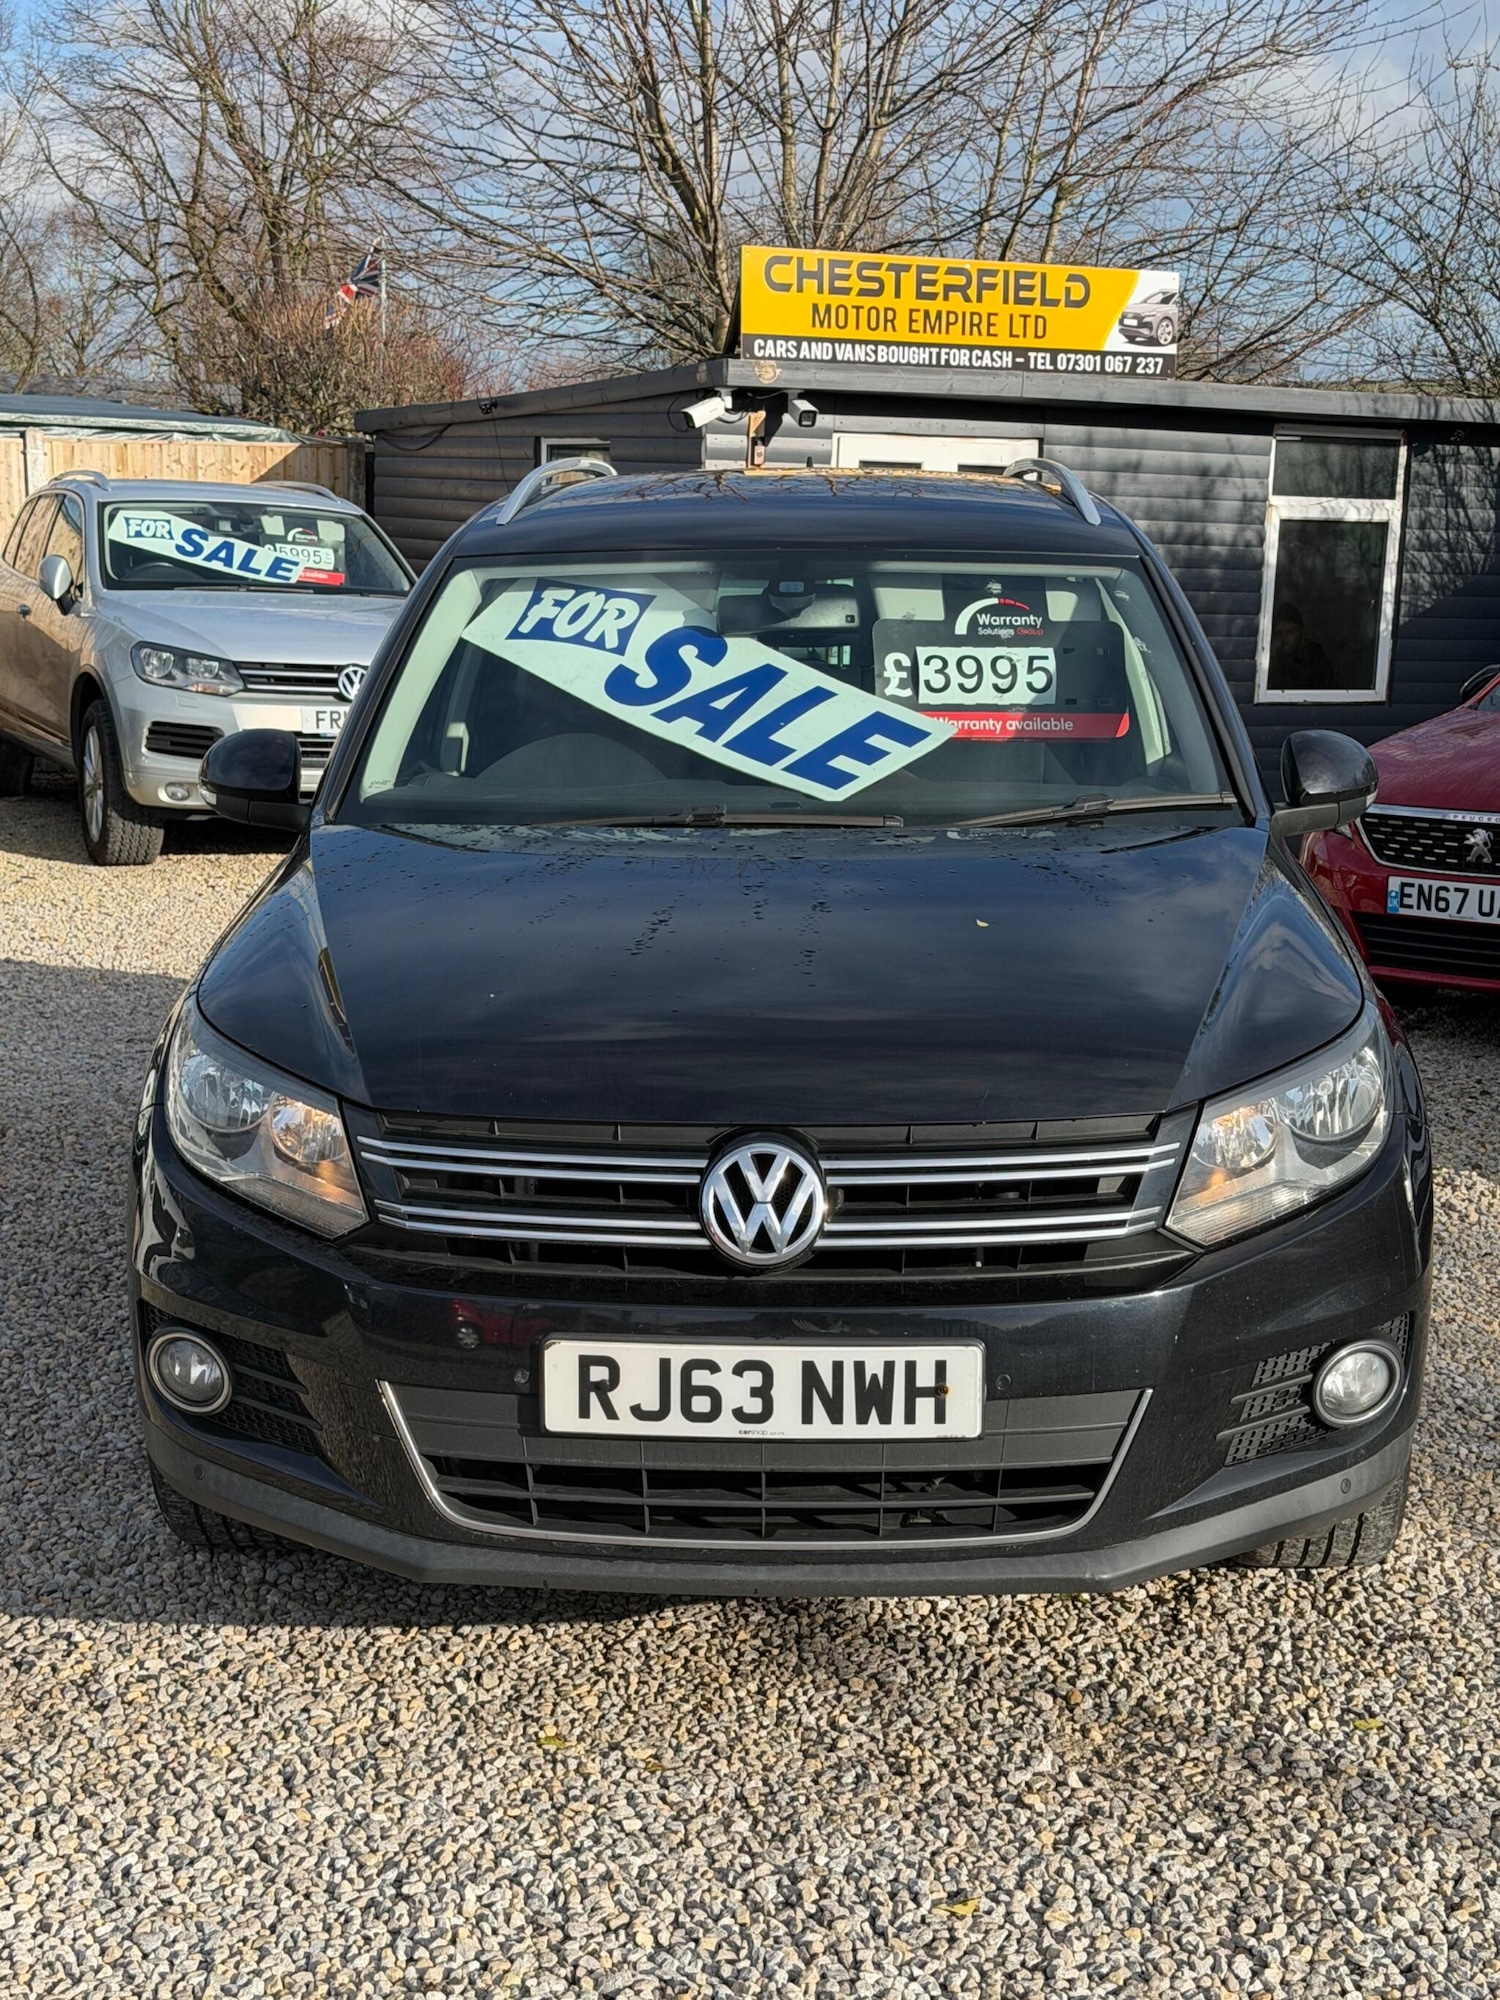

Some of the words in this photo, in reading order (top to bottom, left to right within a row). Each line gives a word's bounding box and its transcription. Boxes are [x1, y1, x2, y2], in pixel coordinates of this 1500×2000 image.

[764, 255, 1091, 309] CHESTERFIELD
[811, 303, 897, 332] MOTOR
[908, 308, 999, 338] EMPIRE
[1009, 312, 1047, 339] LTD
[753, 338, 797, 358] CARS
[799, 341, 834, 360] AND
[834, 343, 876, 363] VANS
[877, 346, 939, 366] BOUGHT
[941, 349, 970, 367] FOR
[972, 349, 1012, 369] CASH
[1028, 352, 1053, 370] TEL
[1057, 353, 1101, 372] 07301
[1104, 355, 1132, 373] 067
[1136, 357, 1163, 375] 237
[129, 519, 172, 540] FOR
[175, 528, 300, 582] SALE
[518, 587, 640, 649] FOR
[976, 613, 1043, 629] Warranty
[978, 627, 1015, 636] Solutions
[316, 711, 348, 729] FR
[604, 625, 933, 790] SALE
[1006, 717, 1074, 731] available
[1400, 881, 1469, 915] EN67
[1477, 888, 1500, 919] U
[578, 1354, 775, 1424] RJ63
[801, 1359, 947, 1425] NWH
